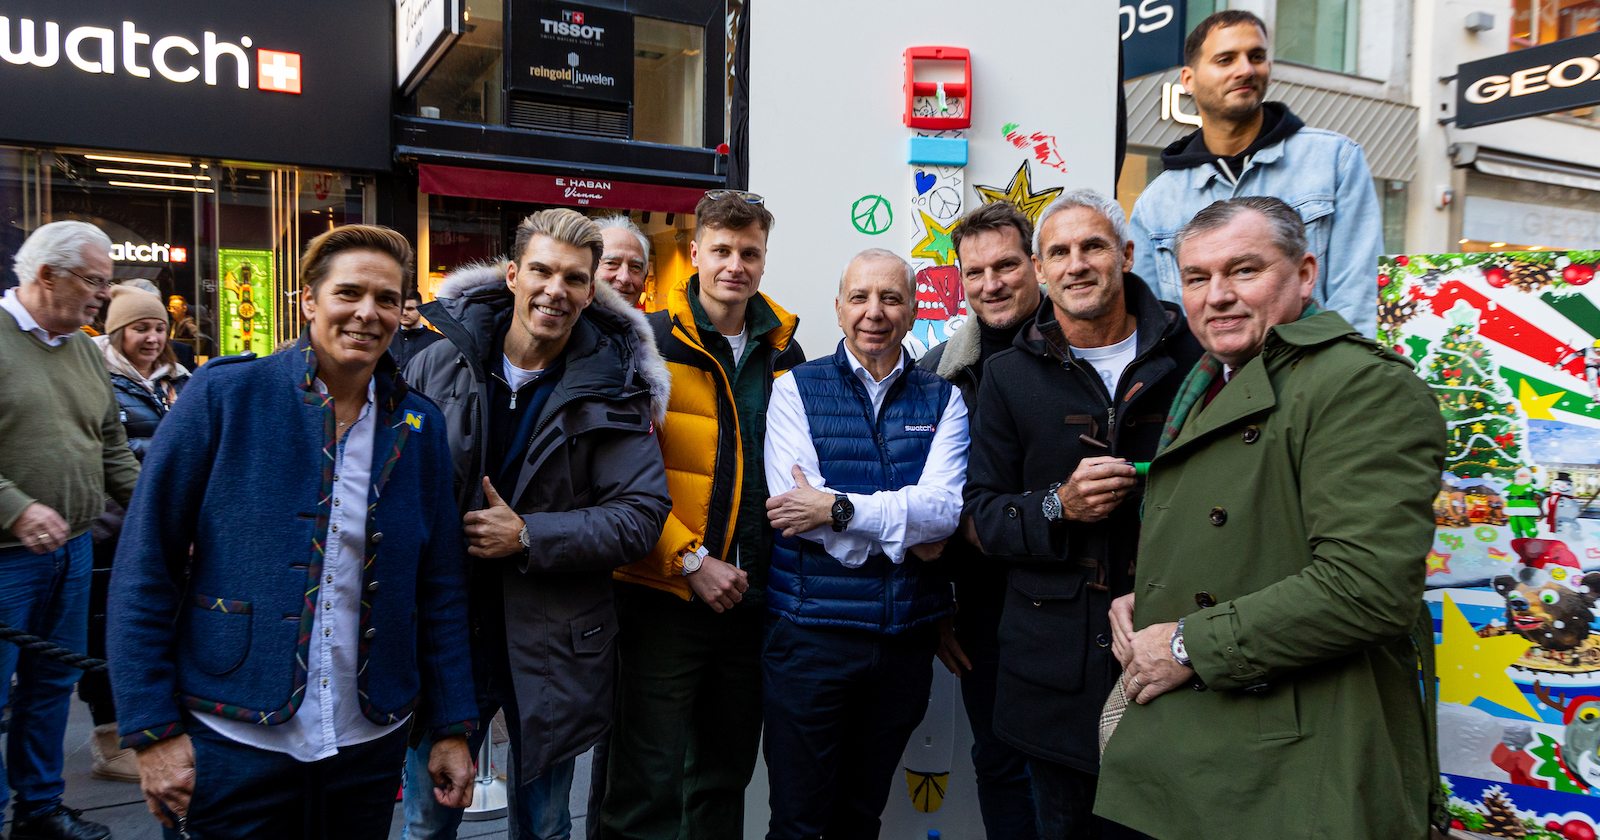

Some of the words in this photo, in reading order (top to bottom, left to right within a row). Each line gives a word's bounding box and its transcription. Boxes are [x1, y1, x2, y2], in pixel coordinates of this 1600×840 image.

[540, 19, 605, 41] TISSOT
[529, 65, 571, 81] reingold
[575, 70, 614, 86] juwelen
[1464, 53, 1600, 104] GEO
[555, 178, 566, 186] E.
[569, 179, 611, 190] HABAN
[564, 187, 603, 199] Vienna
[904, 424, 933, 433] swatch
